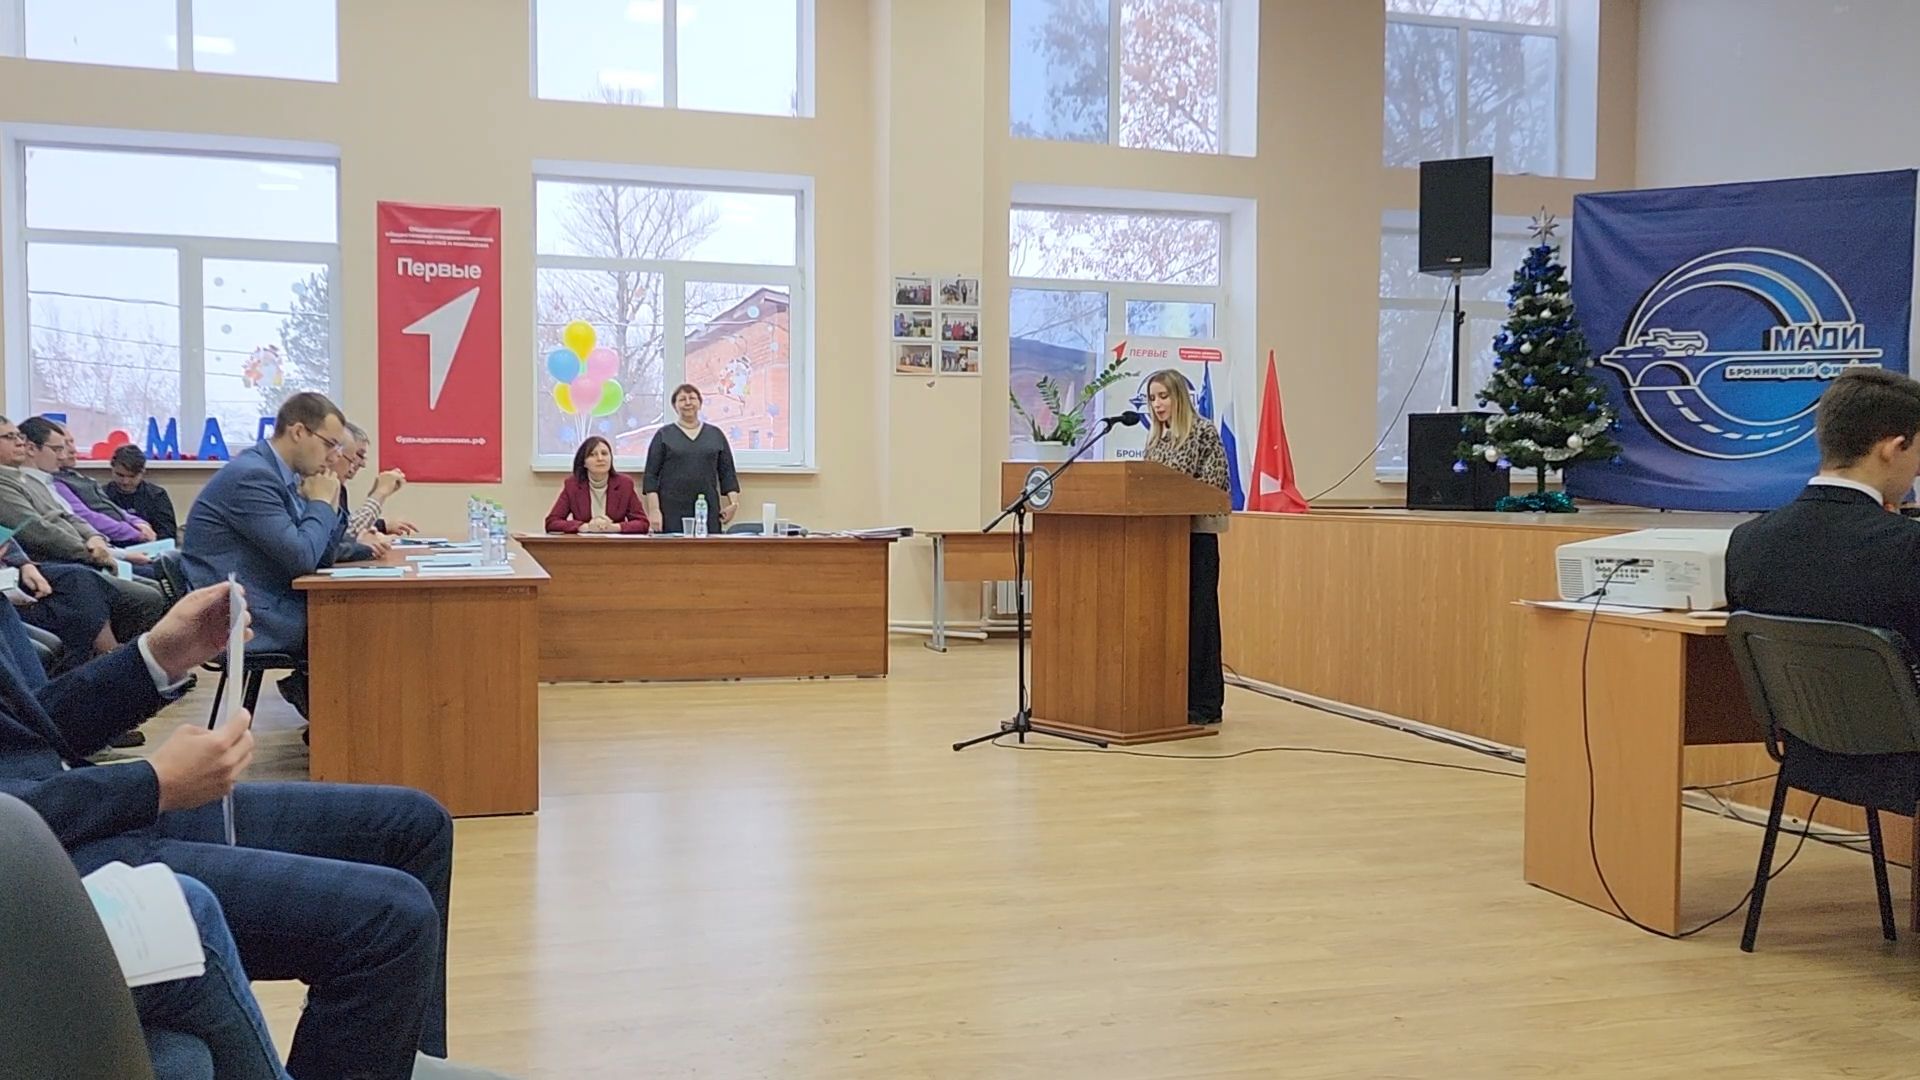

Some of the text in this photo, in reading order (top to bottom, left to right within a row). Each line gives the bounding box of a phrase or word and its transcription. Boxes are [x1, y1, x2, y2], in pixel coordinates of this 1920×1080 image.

[398, 257, 482, 282] Первые
[1772, 325, 1864, 352] МАДИ
[1129, 348, 1169, 358] ПЕРВЫЕ
[1728, 364, 1815, 377] БРОННИЦКИЙ
[1116, 449, 1146, 459] БРОН
